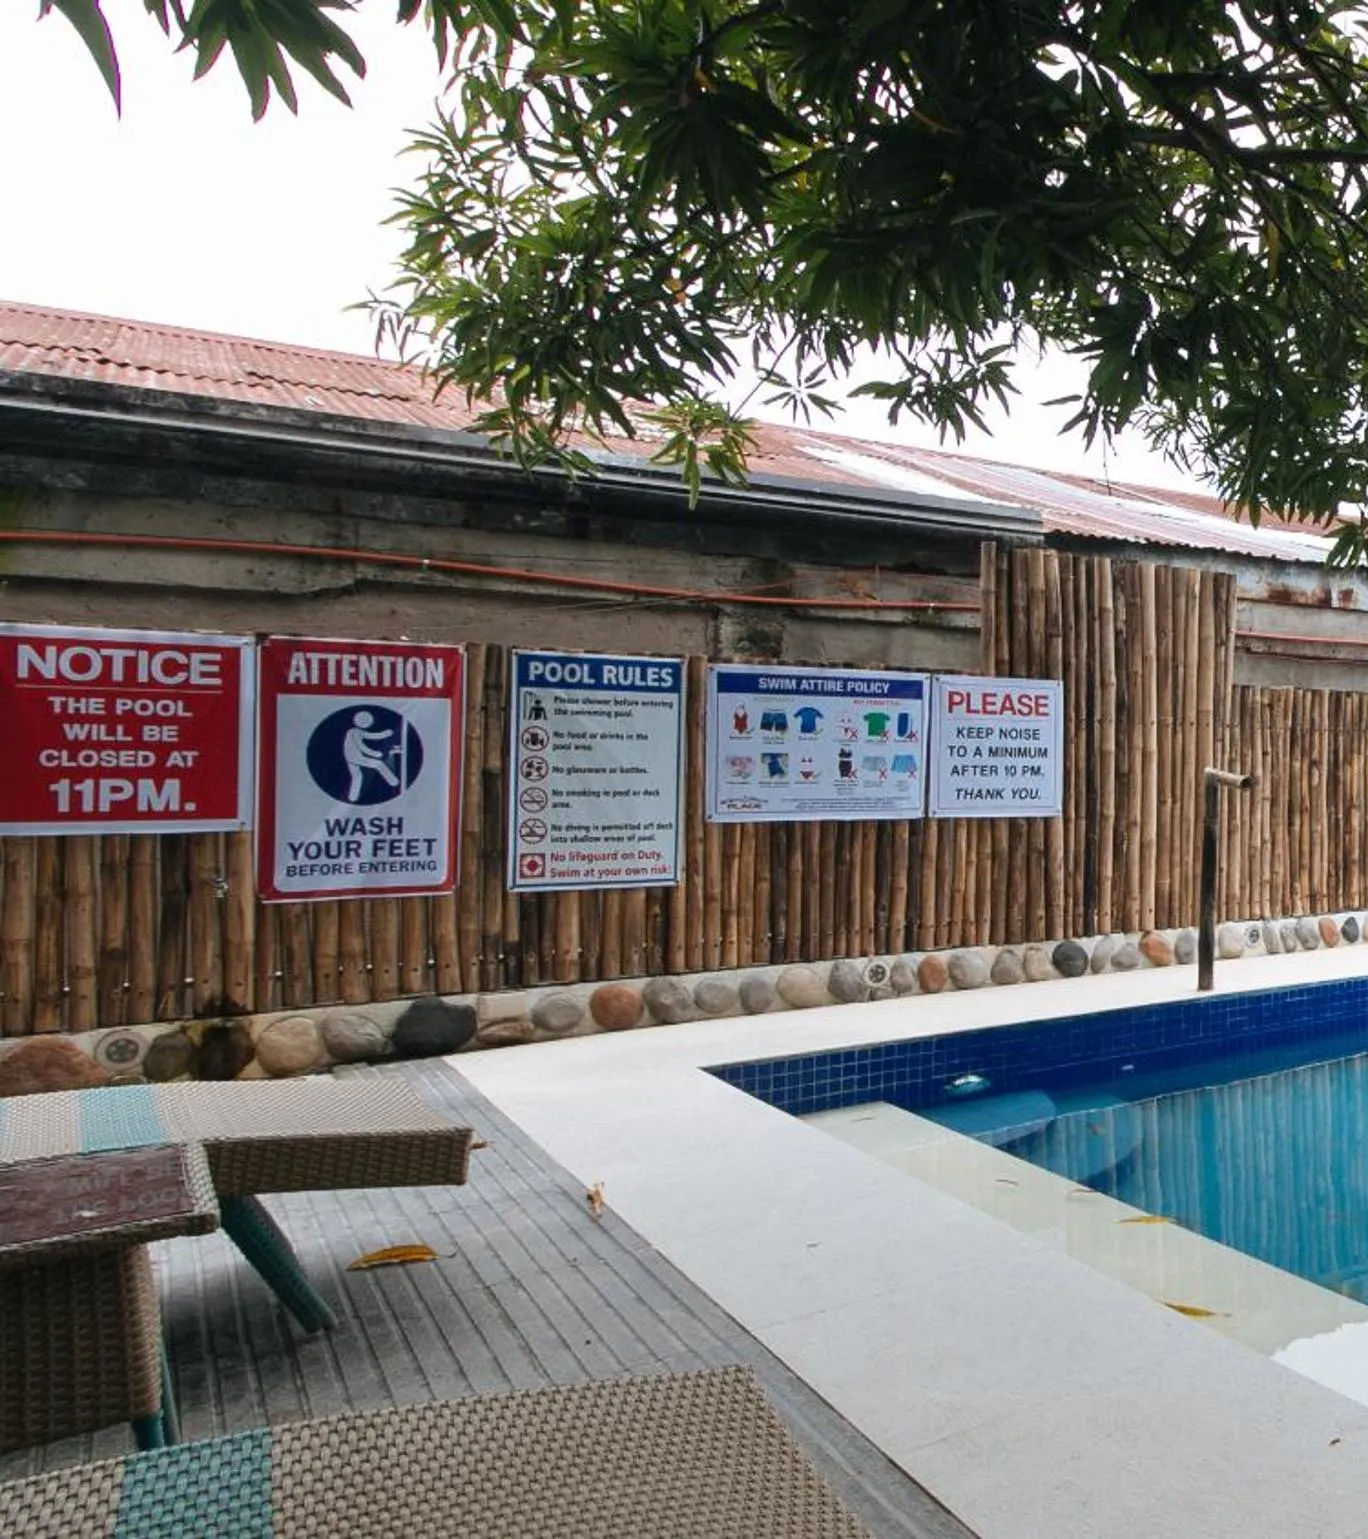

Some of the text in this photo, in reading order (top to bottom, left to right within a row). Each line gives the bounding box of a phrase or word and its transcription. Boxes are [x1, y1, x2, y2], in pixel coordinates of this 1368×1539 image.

[17, 645, 222, 685] NOTICE
[287, 652, 444, 689] ATTENTION
[528, 661, 673, 687] POOL RULES
[758, 677, 890, 694] SWIM ATTIRE POLICY
[48, 696, 193, 717] THE POOL
[554, 696, 579, 705] Please
[614, 698, 639, 706] before
[641, 700, 674, 709] entering
[947, 690, 1050, 716] PLEASE
[571, 709, 612, 718] swimming
[63, 724, 178, 742] WILL BE
[568, 732, 587, 740] food
[600, 732, 624, 740] drinks
[956, 726, 1041, 741] KEEP NOISE
[553, 743, 572, 752] pool
[948, 745, 1048, 759] TO A MINIMUM
[39, 750, 199, 768] CLOSED AT
[950, 764, 1045, 778] AFTER 10 PM.
[49, 779, 197, 813] 11PM.
[552, 789, 564, 797] No
[566, 789, 601, 798] smoking
[612, 789, 631, 798] pool
[955, 788, 1042, 801] THANK YOU.
[325, 816, 404, 837] WASH
[551, 824, 563, 832] No
[565, 823, 590, 832] diving
[602, 823, 641, 832] permitted
[656, 822, 674, 830] deck
[570, 835, 601, 843] shallow
[288, 838, 437, 860] YOUR FEET
[550, 853, 566, 862] No
[286, 860, 438, 877] BEFORE ENTERING
[550, 867, 580, 878] Swim
[583, 868, 595, 877] at
[597, 868, 622, 879] your
[625, 867, 648, 875] own
